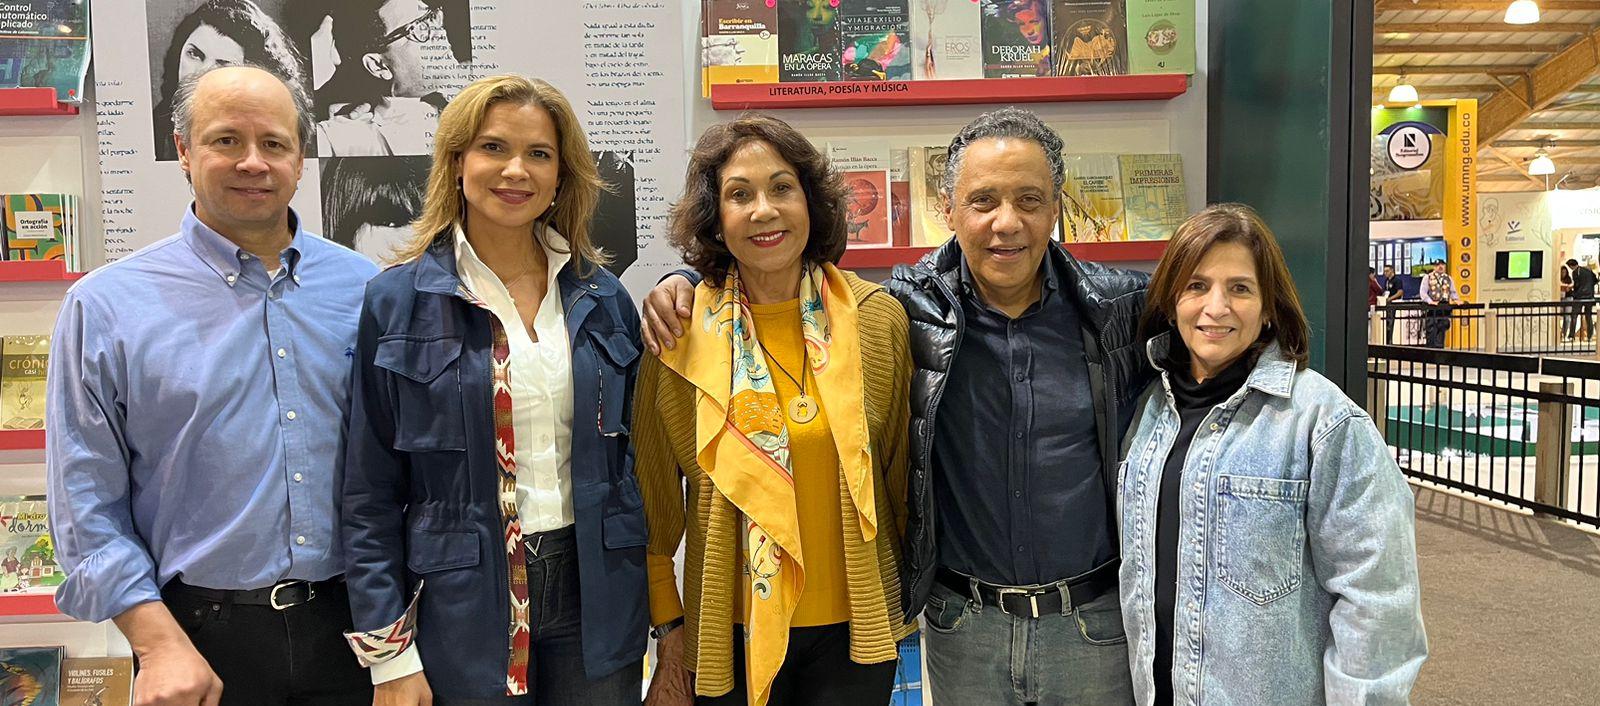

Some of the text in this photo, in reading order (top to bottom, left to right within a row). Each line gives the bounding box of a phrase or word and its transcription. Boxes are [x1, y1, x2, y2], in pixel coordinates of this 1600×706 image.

[0, 12, 47, 20] utomático
[0, 20, 32, 28] plicado
[992, 46, 1041, 54] DEBORAH
[783, 54, 833, 64] MARACAS
[1000, 52, 1034, 62] KRUEL
[806, 62, 832, 70] ÓPERA
[770, 83, 908, 97] LITERATURA, POESÍA Y MÚSICA
[1460, 112, 1472, 227] www.umng.edu.co
[8, 516, 49, 533] dorm
